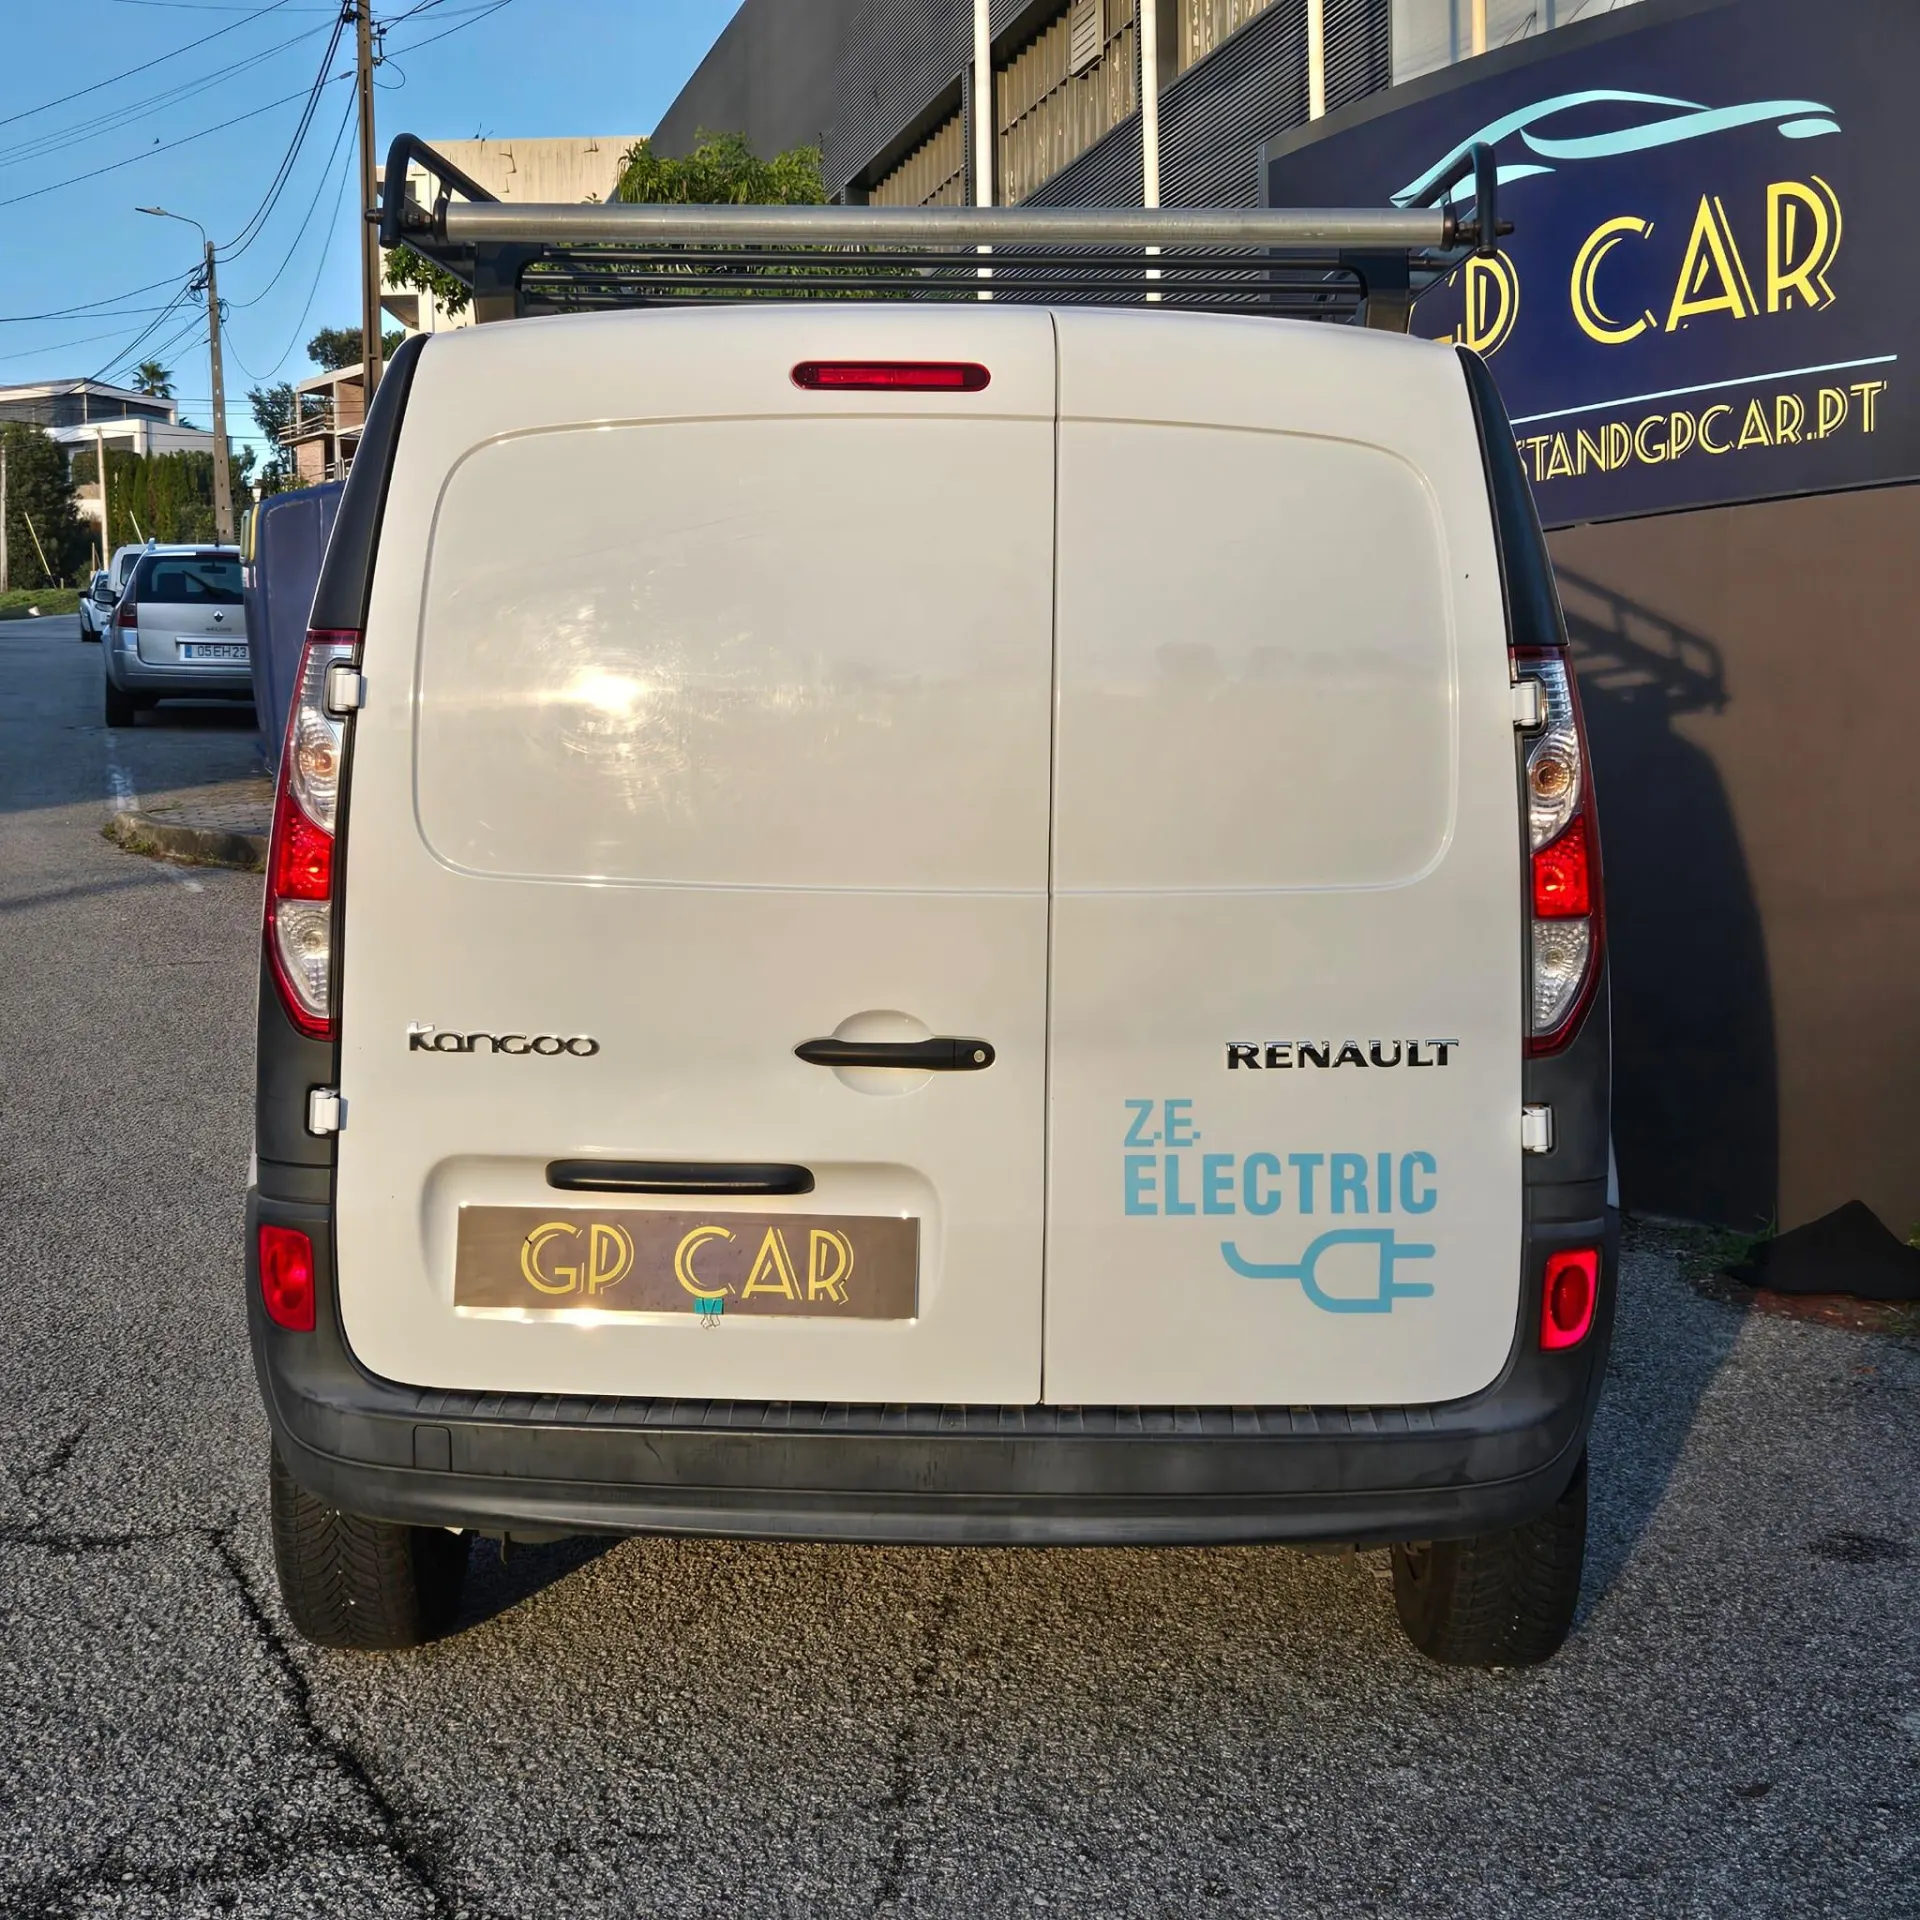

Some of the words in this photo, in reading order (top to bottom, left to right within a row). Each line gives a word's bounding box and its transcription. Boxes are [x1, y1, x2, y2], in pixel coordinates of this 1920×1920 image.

[1407, 248, 1520, 360] P
[1570, 174, 1843, 345] CAR
[1225, 1038, 1460, 1070] RENAULT
[1123, 1099, 1202, 1148] Z.E.
[1124, 1151, 1438, 1216] ELECTRIC
[520, 1221, 635, 1296] GP
[674, 1225, 855, 1306] CAR
